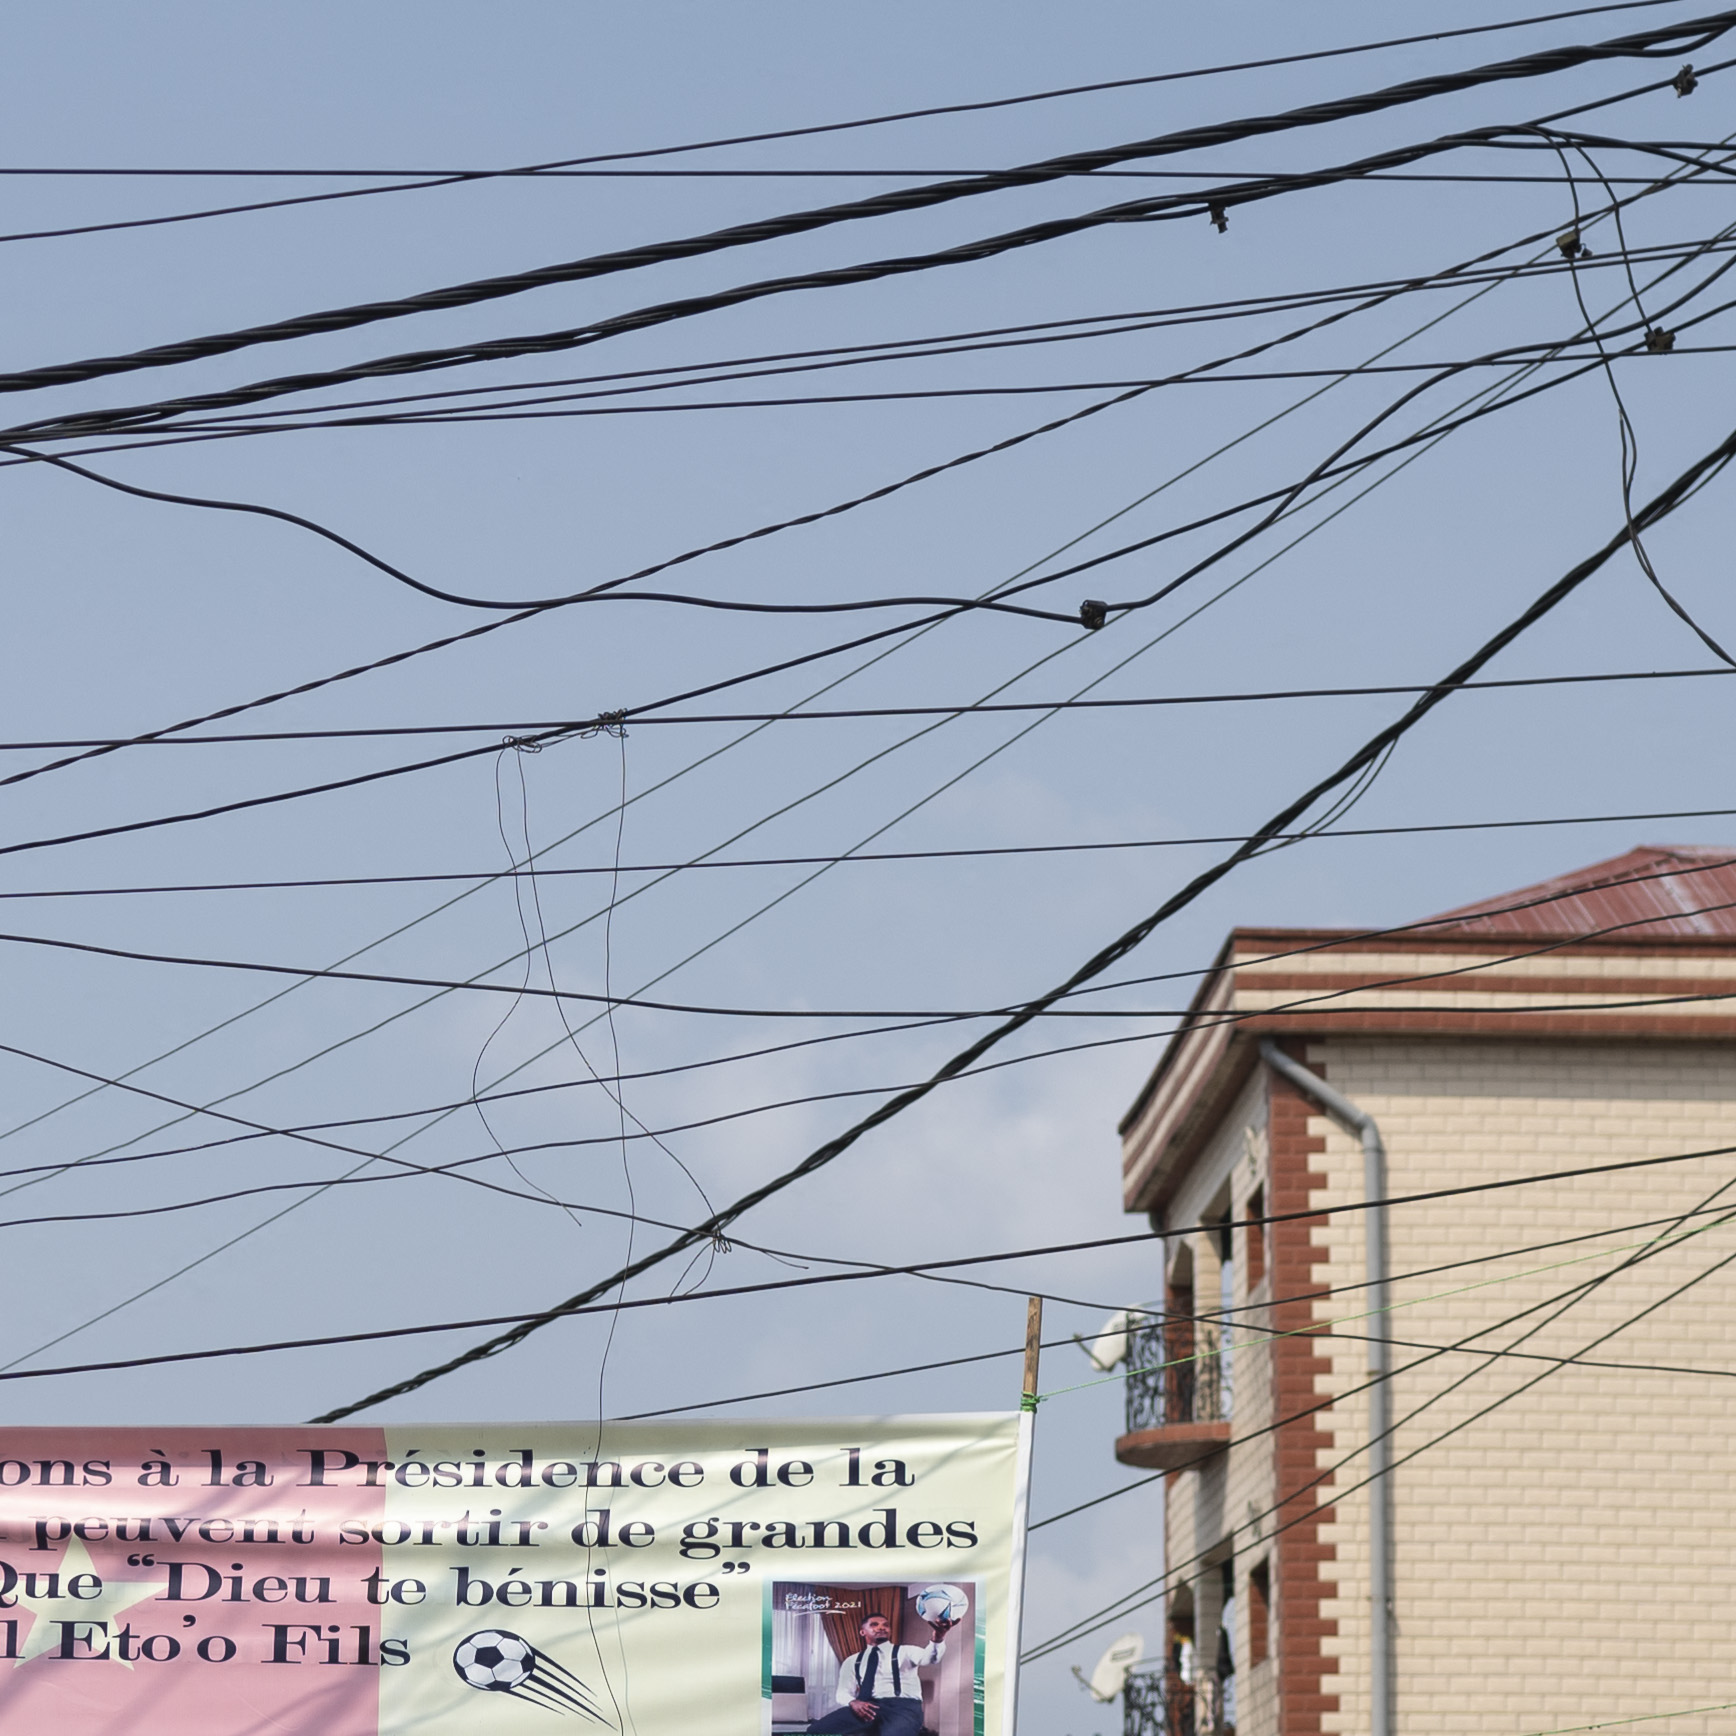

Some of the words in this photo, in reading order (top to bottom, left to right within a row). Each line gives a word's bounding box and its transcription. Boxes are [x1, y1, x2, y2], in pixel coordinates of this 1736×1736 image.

[137, 1449, 180, 1487] à
[201, 1449, 274, 1487] la
[296, 1449, 704, 1487] Présidence
[729, 1448, 814, 1487] de
[839, 1447, 915, 1487] la
[29, 1509, 314, 1551] peuvent
[339, 1508, 548, 1547] sortir
[571, 1509, 655, 1548] de
[679, 1508, 978, 1560] grandes
[361, 1566, 426, 1605] te
[834, 1601, 861, 1609] 2021
[261, 1624, 411, 1666] Fils
